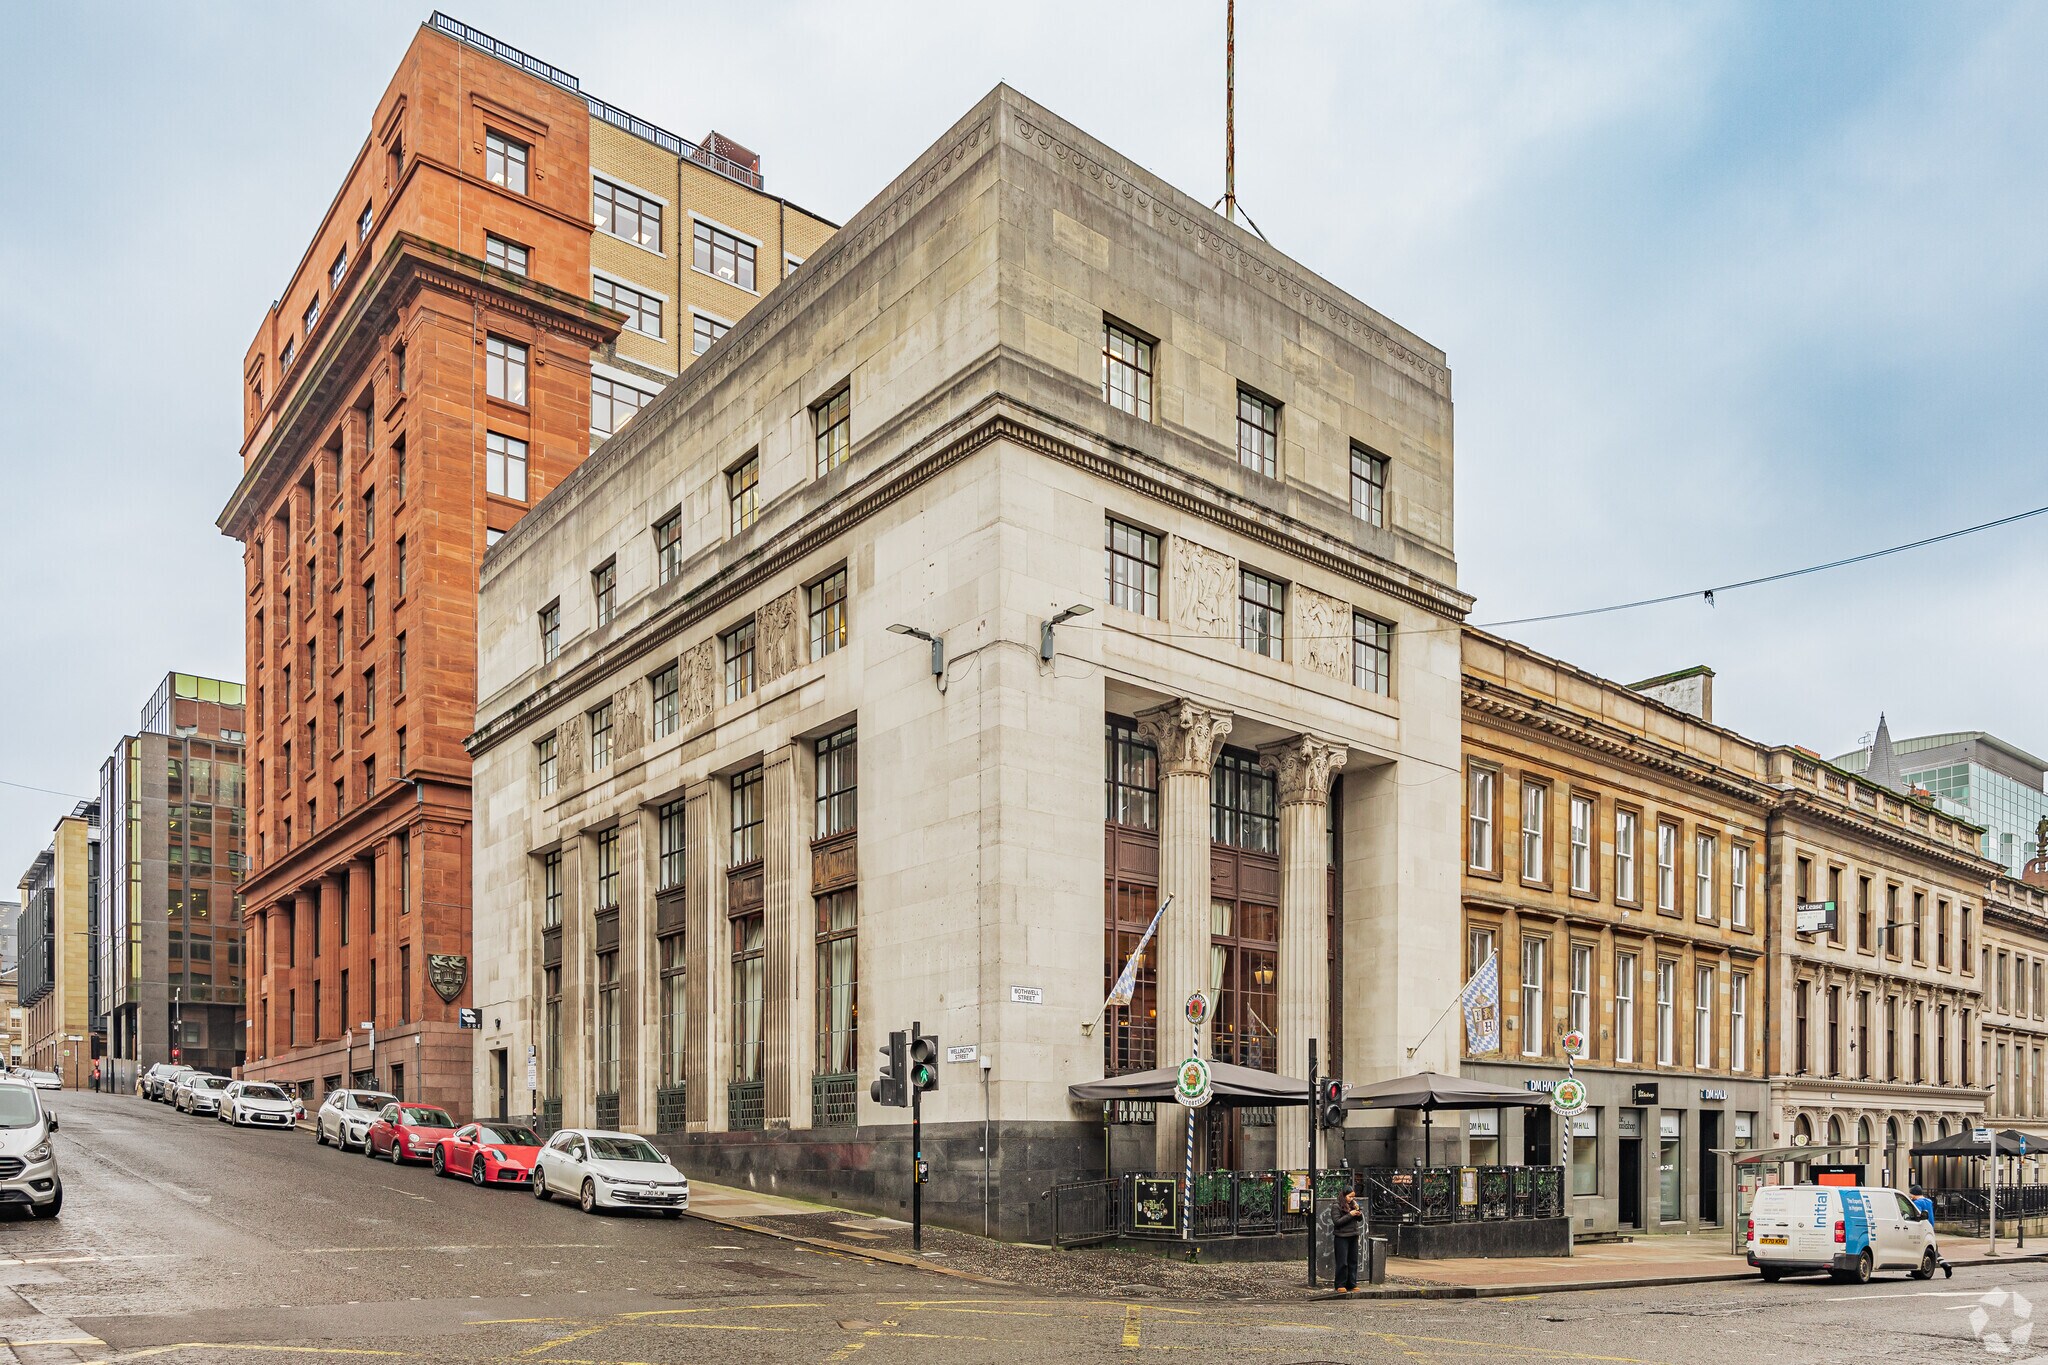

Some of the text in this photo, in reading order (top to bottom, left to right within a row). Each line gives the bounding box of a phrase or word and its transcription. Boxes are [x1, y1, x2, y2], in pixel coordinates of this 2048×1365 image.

[1014, 988, 1039, 996] BOTHWELL
[1530, 1080, 1542, 1092] DM
[1478, 1122, 1490, 1131] HALL
[1814, 1193, 1828, 1228] Initial
